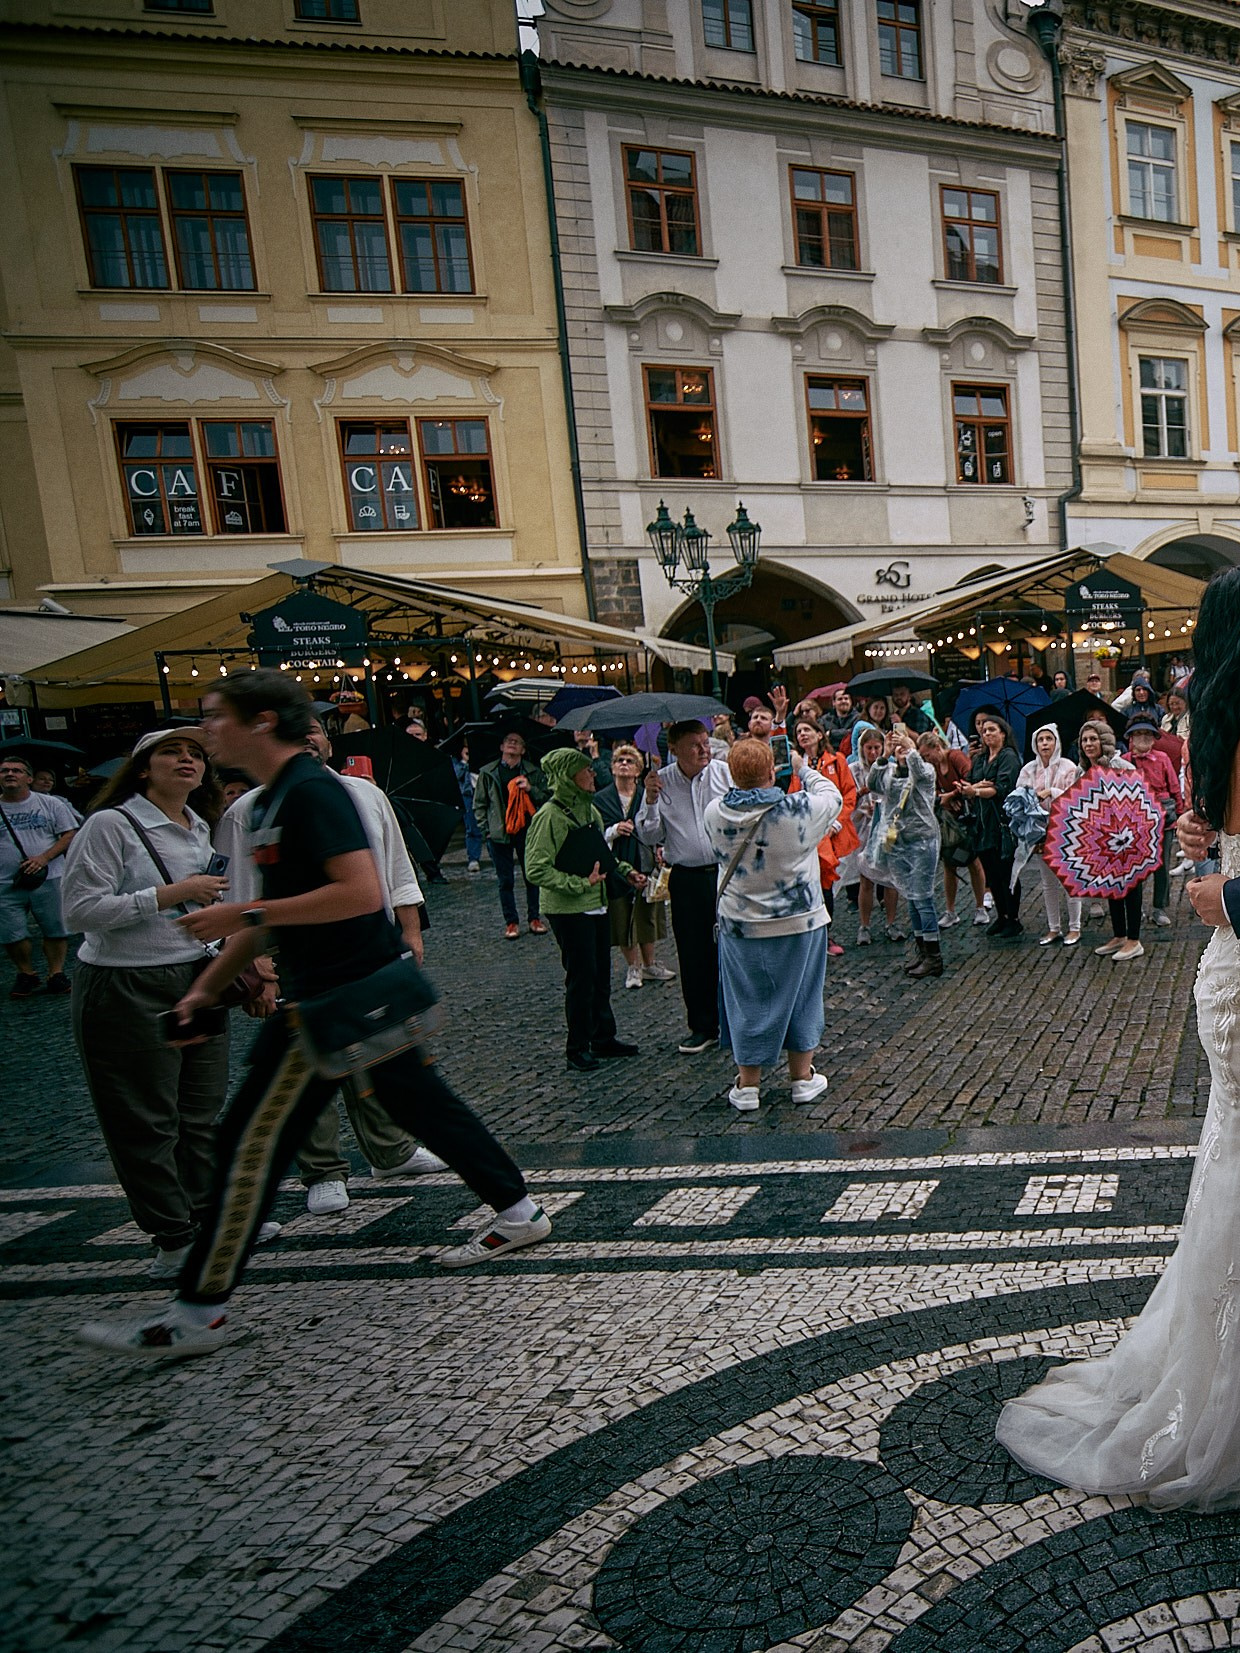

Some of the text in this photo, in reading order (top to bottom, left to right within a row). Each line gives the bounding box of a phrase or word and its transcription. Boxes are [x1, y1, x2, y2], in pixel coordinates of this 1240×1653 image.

[174, 505, 196, 513] break
[178, 512, 193, 520] fast
[857, 592, 936, 603] GRAND HOTE
[293, 624, 317, 632] TORO
[317, 623, 346, 631] NEGRO
[293, 637, 331, 645] STEAKS
